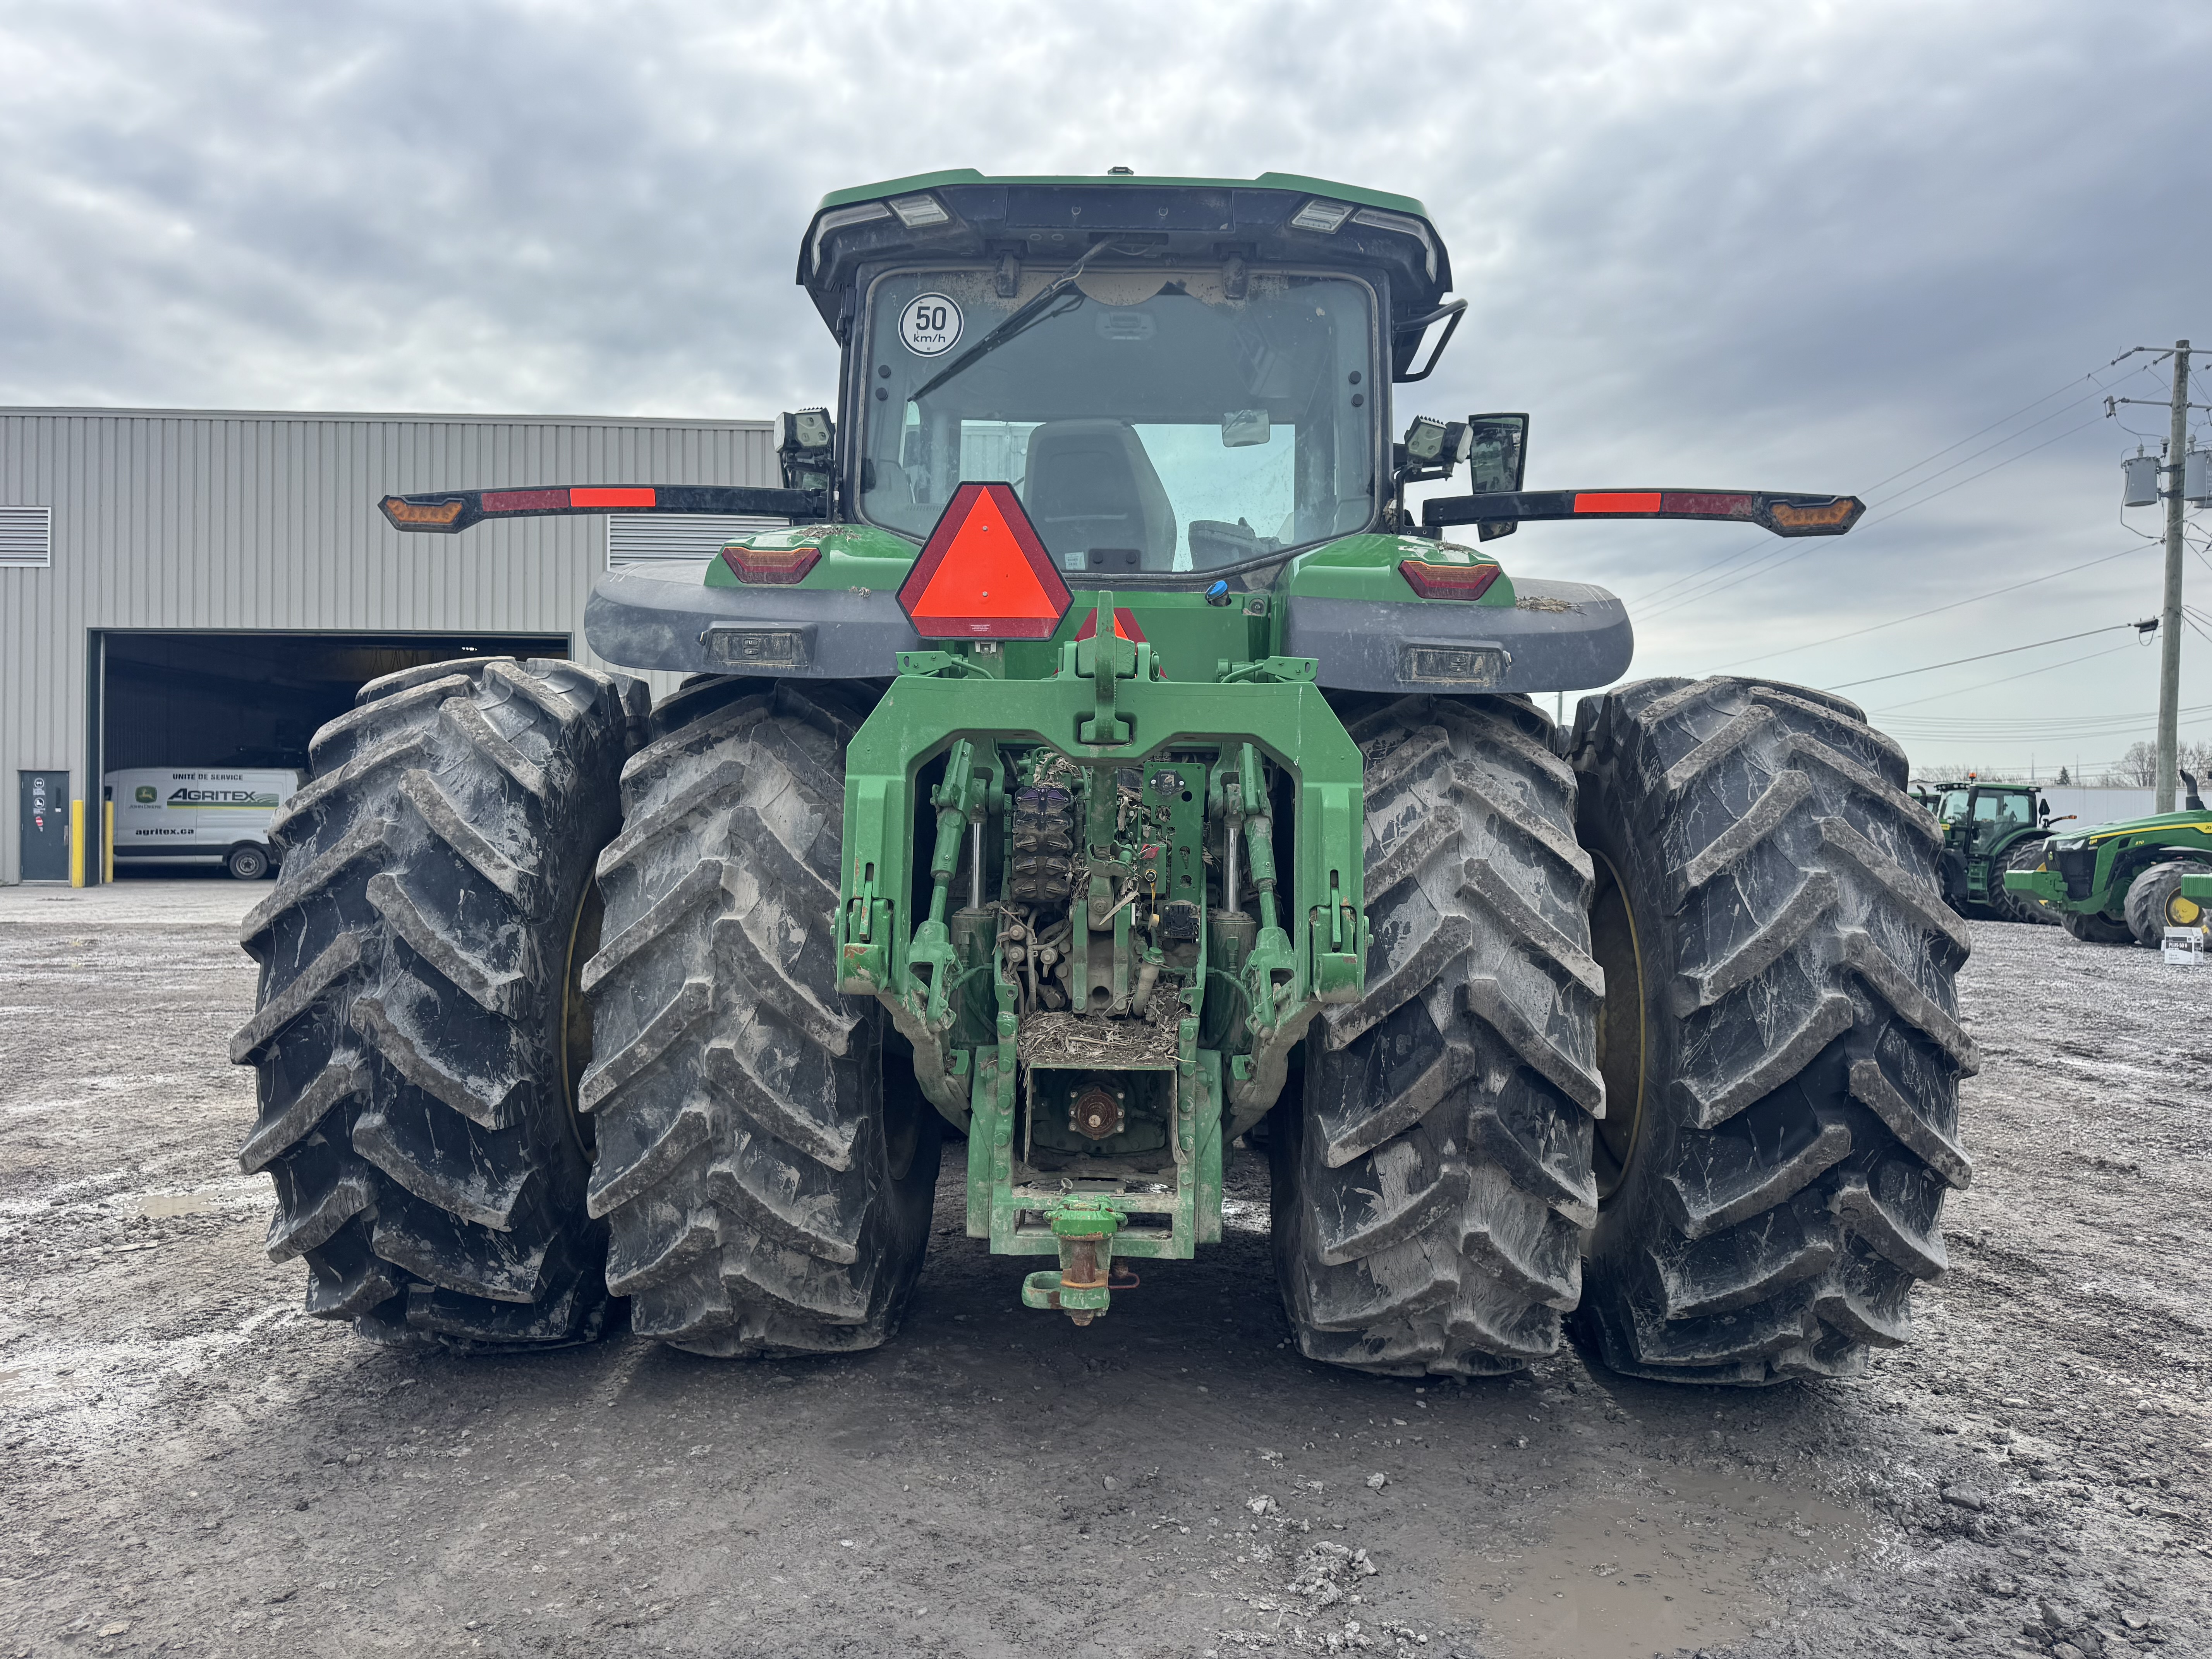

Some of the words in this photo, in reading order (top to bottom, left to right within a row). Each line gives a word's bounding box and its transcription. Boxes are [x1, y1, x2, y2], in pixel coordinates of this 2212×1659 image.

[916, 306, 946, 330] 50
[914, 333, 946, 343] km/h
[168, 788, 256, 801] AGRITEX
